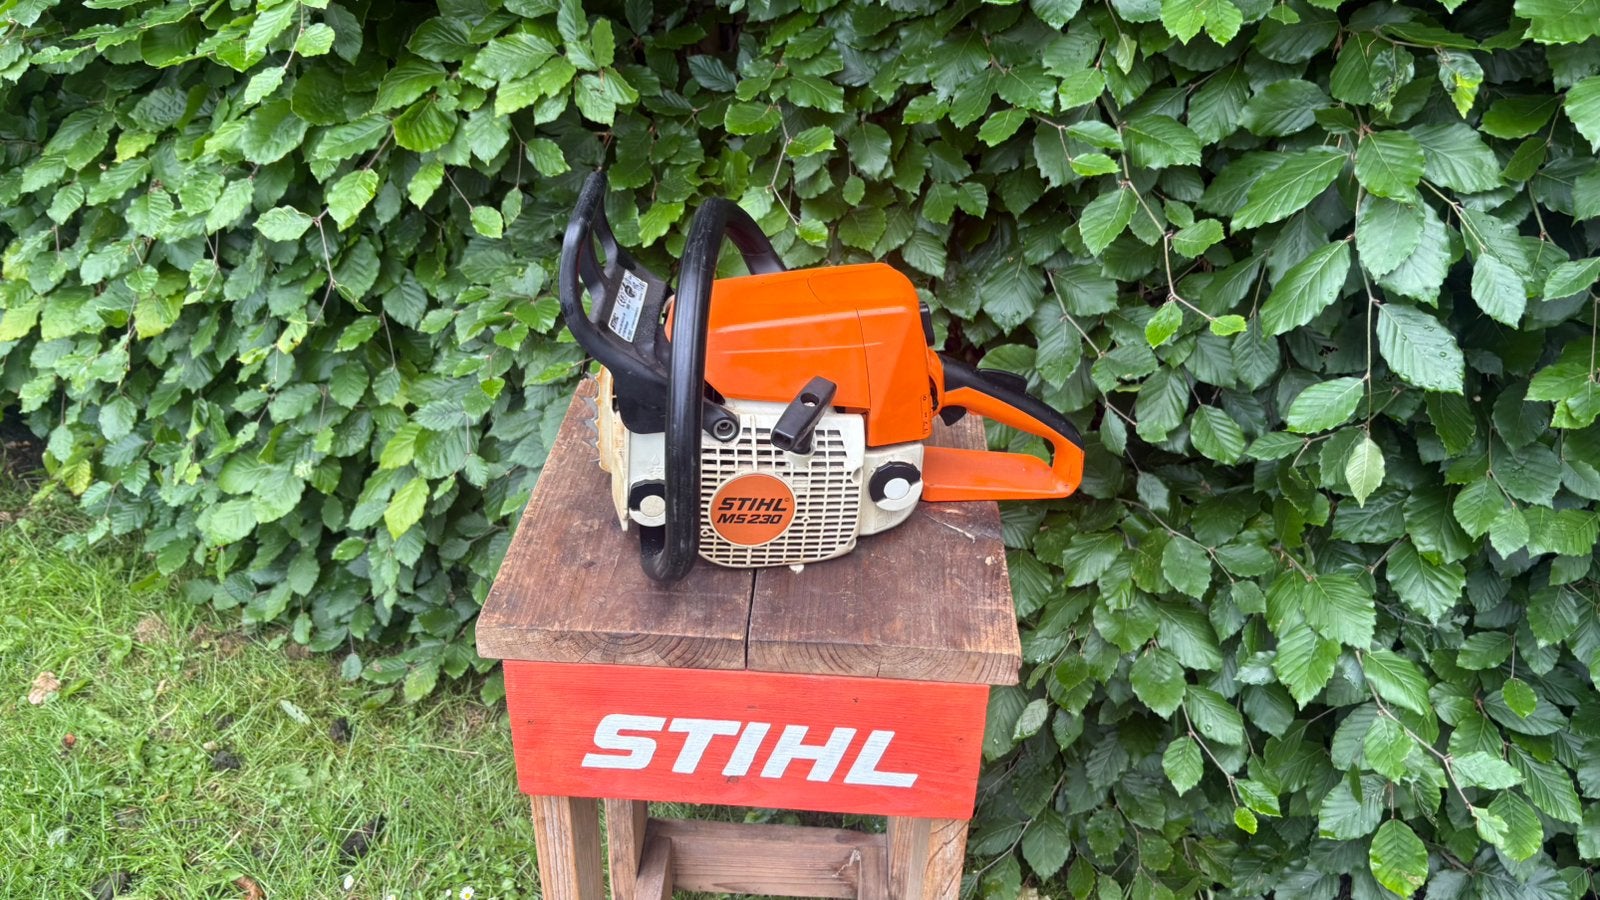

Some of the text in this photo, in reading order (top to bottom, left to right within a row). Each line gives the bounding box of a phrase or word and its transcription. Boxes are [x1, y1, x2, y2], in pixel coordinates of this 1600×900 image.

[717, 497, 787, 512] STIHL
[716, 513, 783, 525] MS 230
[581, 713, 919, 788] STIHL
